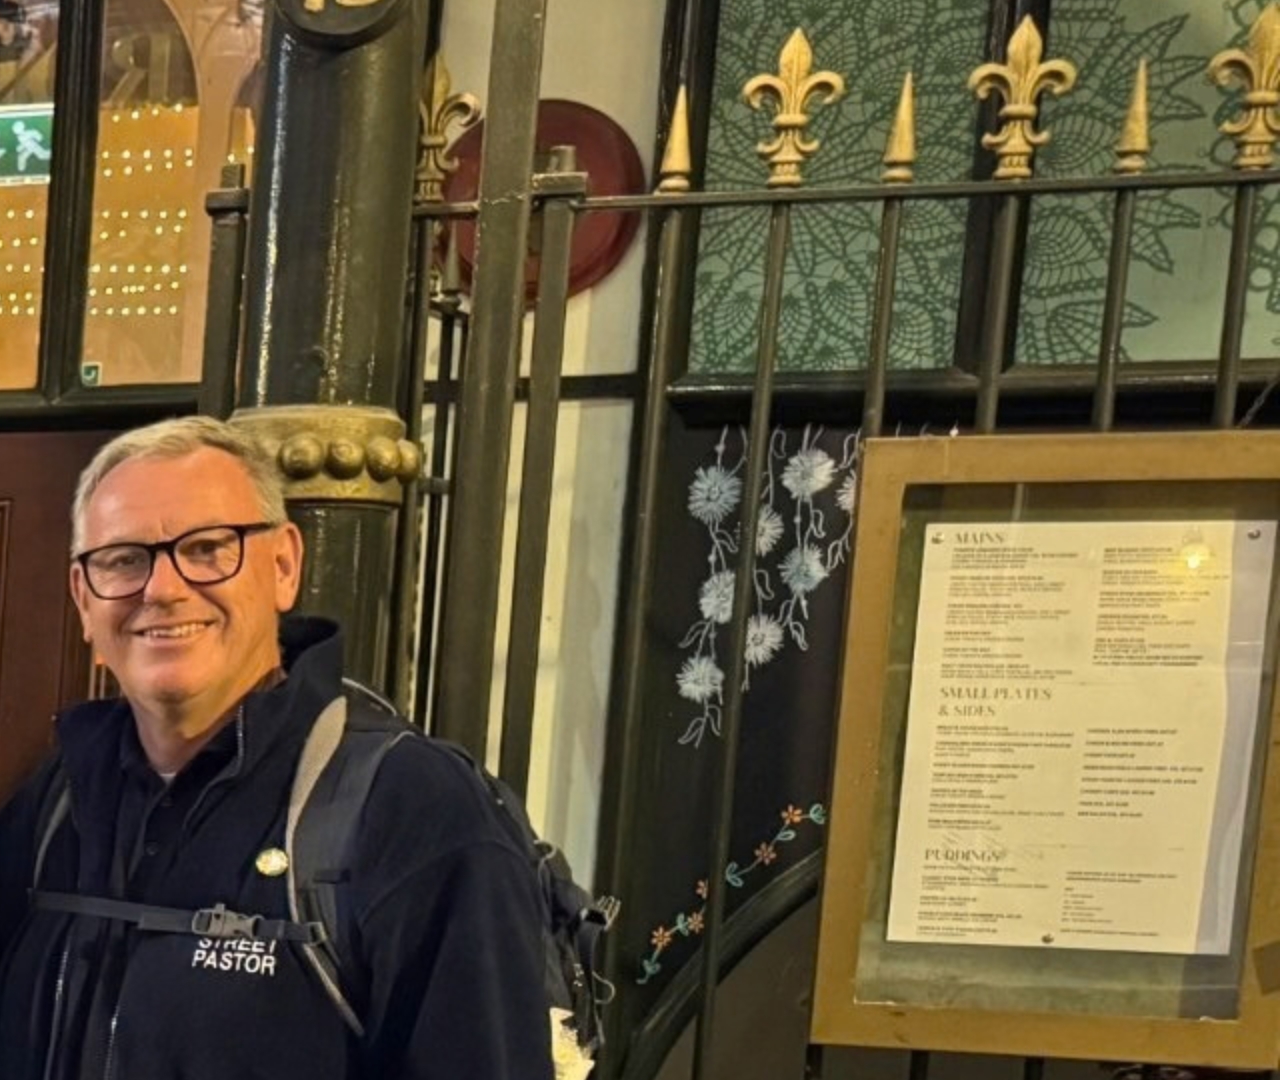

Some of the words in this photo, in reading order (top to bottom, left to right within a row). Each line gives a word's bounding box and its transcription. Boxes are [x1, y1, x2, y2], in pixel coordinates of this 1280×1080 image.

[953, 532, 1006, 545] MAINS
[939, 686, 991, 700] SMALL
[993, 687, 1053, 701] PLATES
[937, 705, 949, 717] &
[953, 705, 996, 717] SIDES
[925, 848, 1000, 863] PUDDINGS
[191, 949, 277, 977] PASTOR
